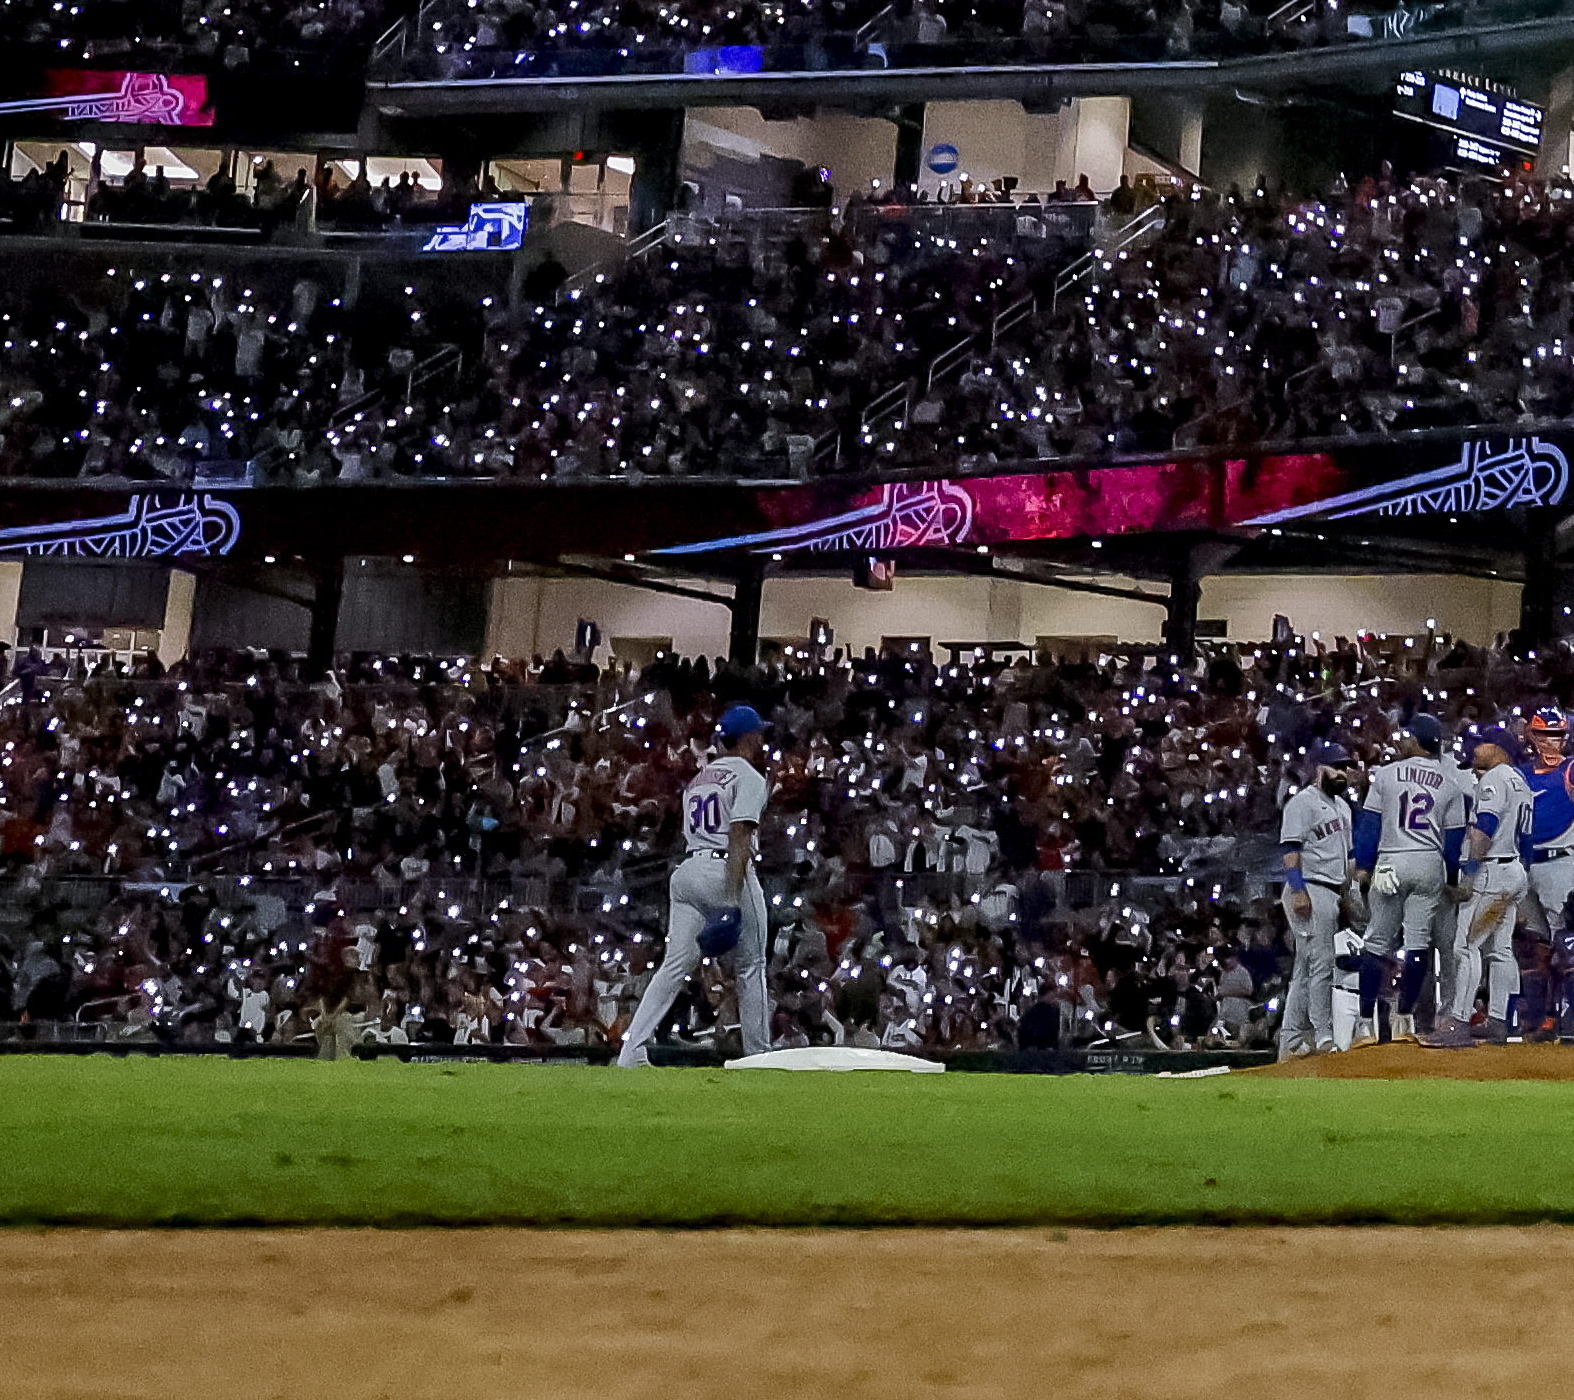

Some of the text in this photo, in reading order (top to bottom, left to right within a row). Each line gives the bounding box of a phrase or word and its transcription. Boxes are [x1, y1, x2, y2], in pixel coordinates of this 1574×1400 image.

[1397, 766, 1444, 790] LINDOR
[689, 791, 722, 835] 30
[1398, 790, 1434, 830] 12
